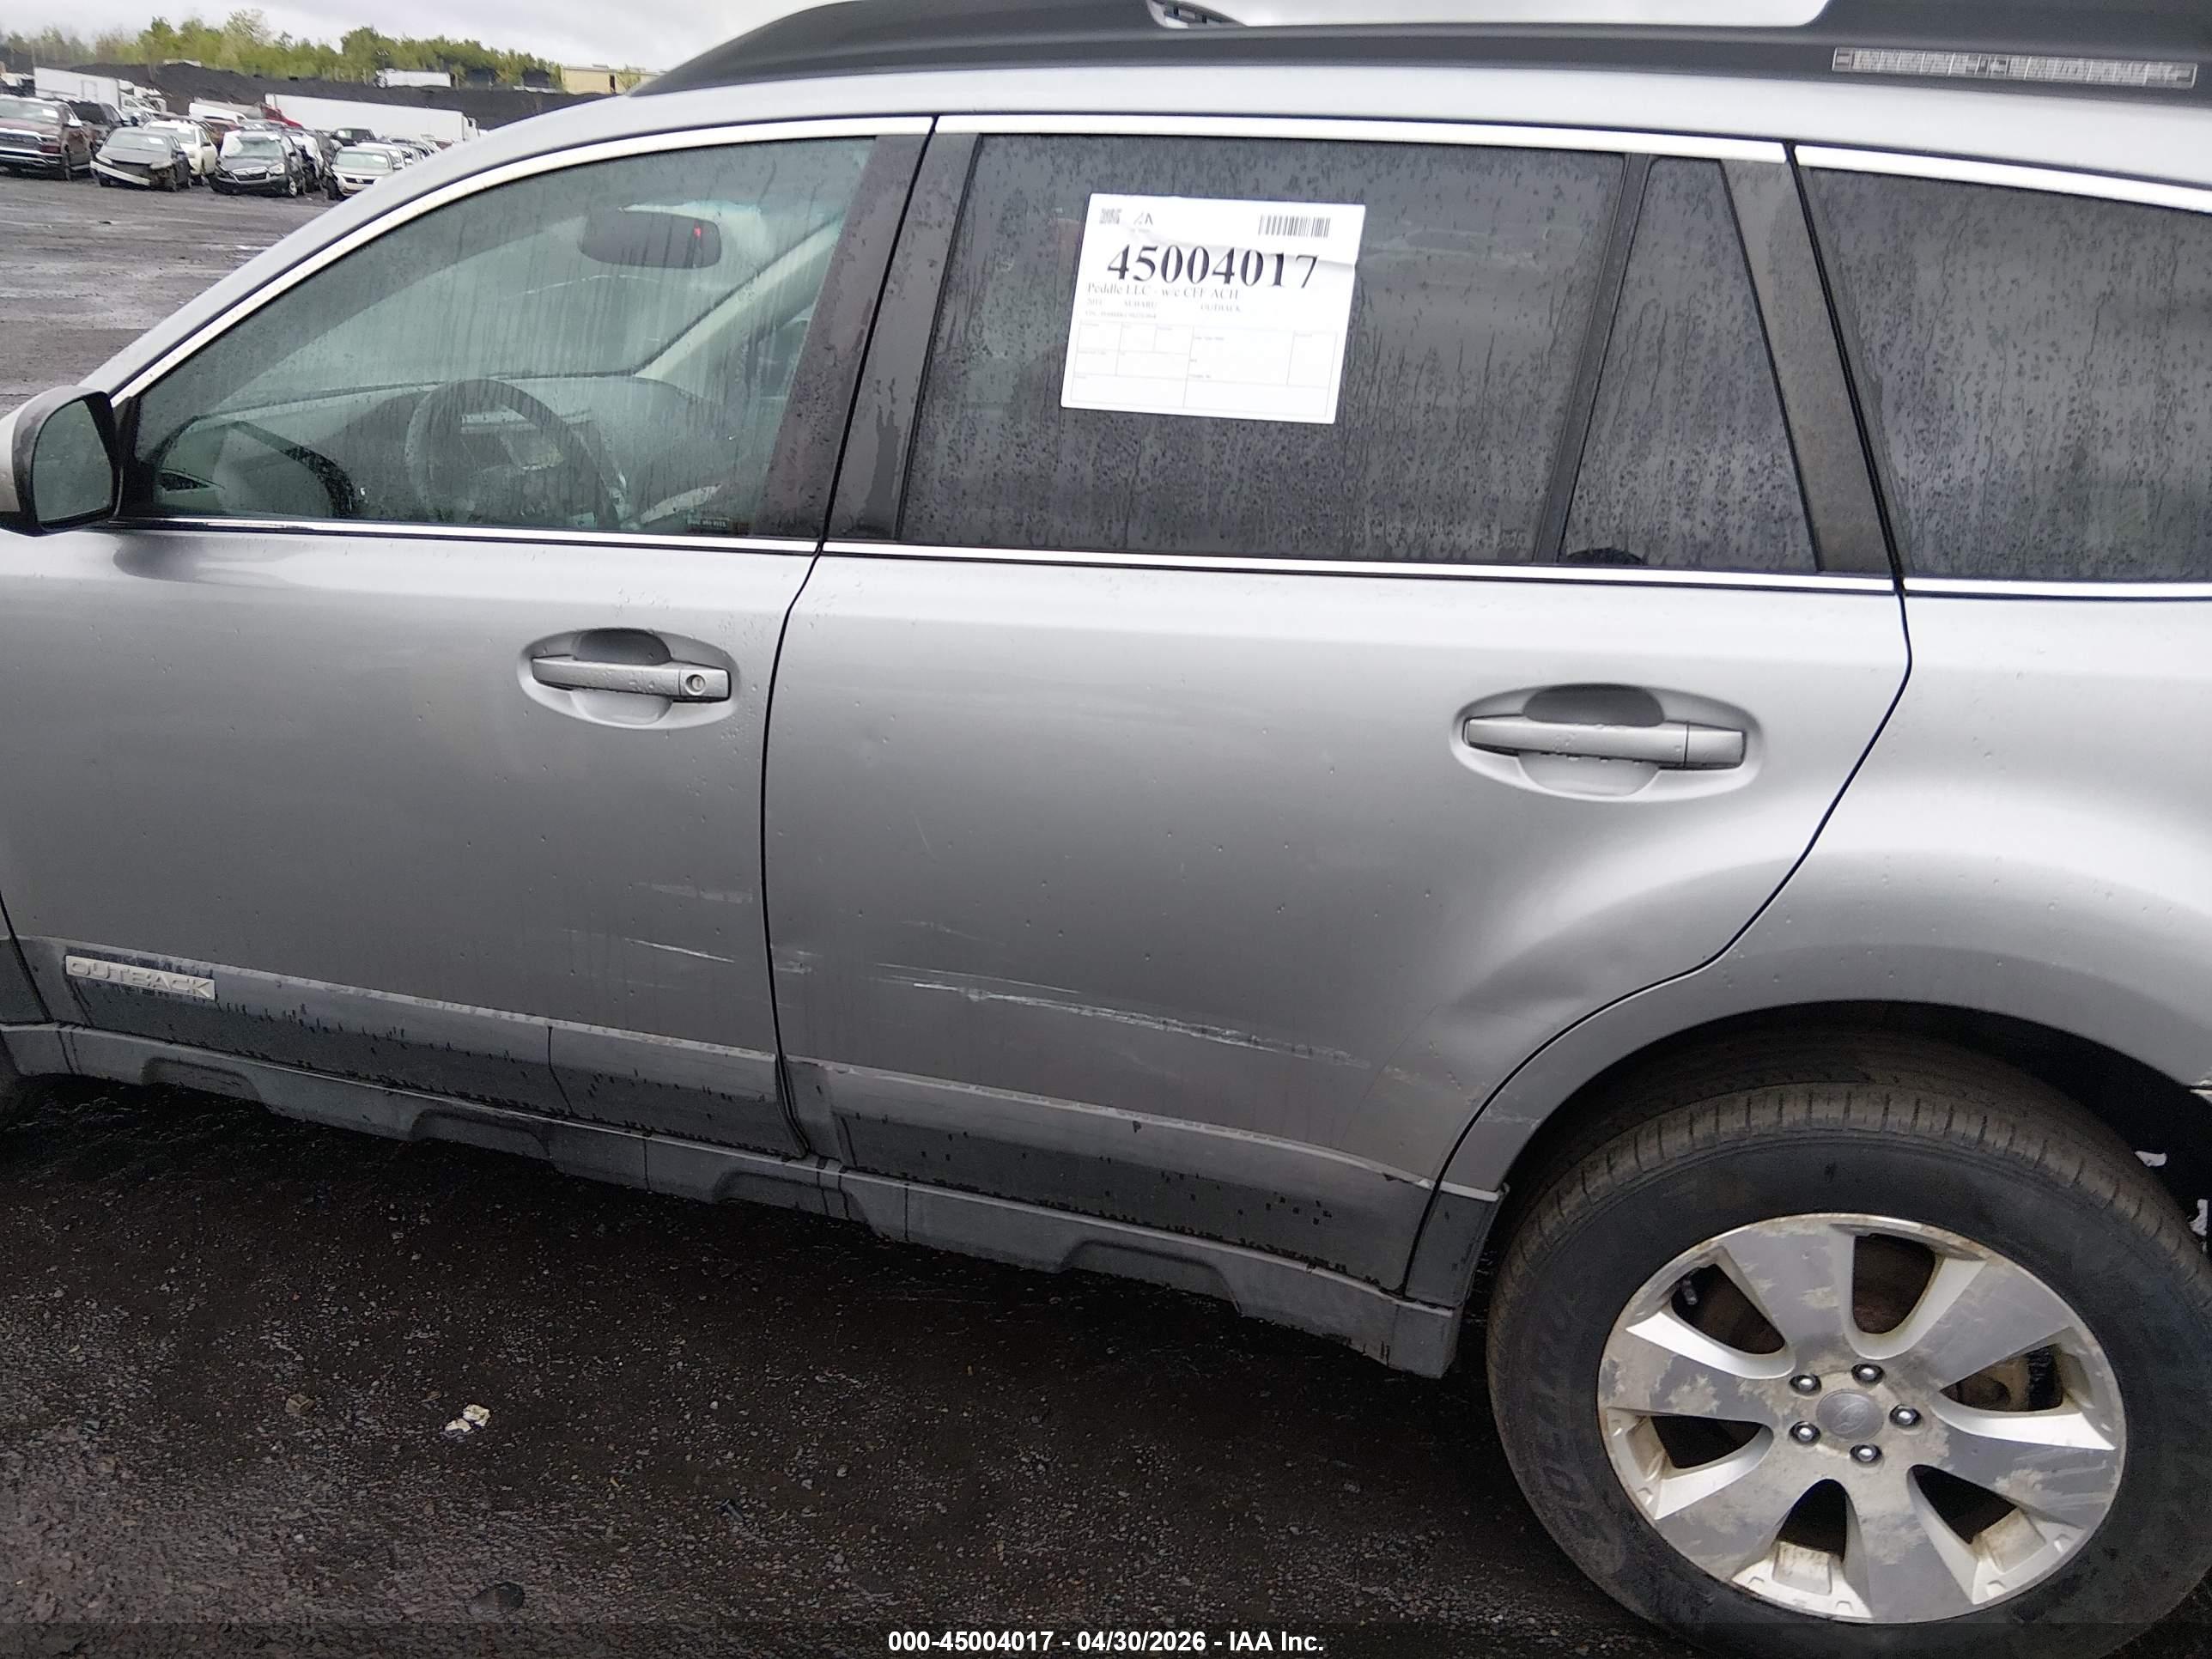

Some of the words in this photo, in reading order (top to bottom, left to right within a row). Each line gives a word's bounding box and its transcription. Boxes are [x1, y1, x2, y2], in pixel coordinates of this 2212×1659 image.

[1107, 245, 1319, 289] 45004017
[1086, 282, 1122, 295] Peddle
[1126, 283, 1152, 296] LLC
[70, 959, 211, 999] OUTBACK
